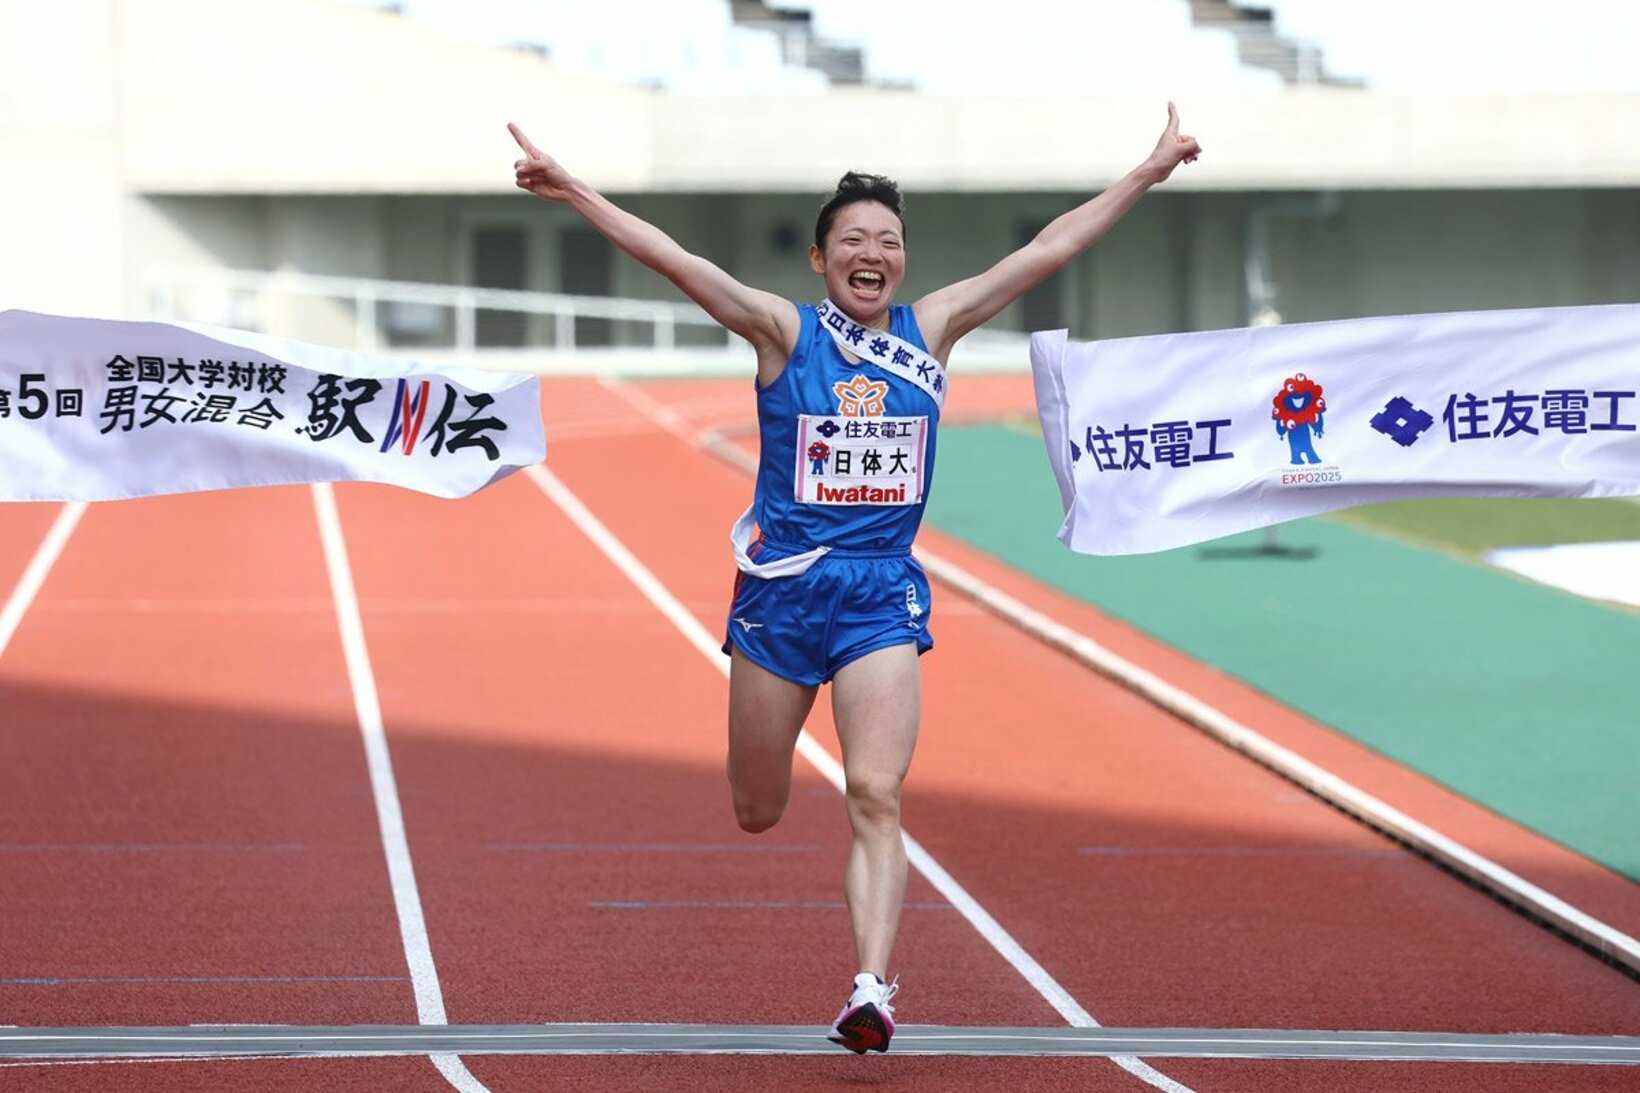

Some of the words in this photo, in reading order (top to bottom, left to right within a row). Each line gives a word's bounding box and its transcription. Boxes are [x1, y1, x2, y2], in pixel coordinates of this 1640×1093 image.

[106, 354, 287, 394] 全国大学対校
[99, 384, 285, 434] 男女混合
[1442, 389, 1637, 442] 住友電工
[844, 420, 912, 439] 住友電工
[1085, 419, 1234, 472] 住友電工
[835, 447, 908, 476] 日体大
[1282, 471, 1342, 485] EXPO2025
[816, 482, 905, 503] Iwatani
